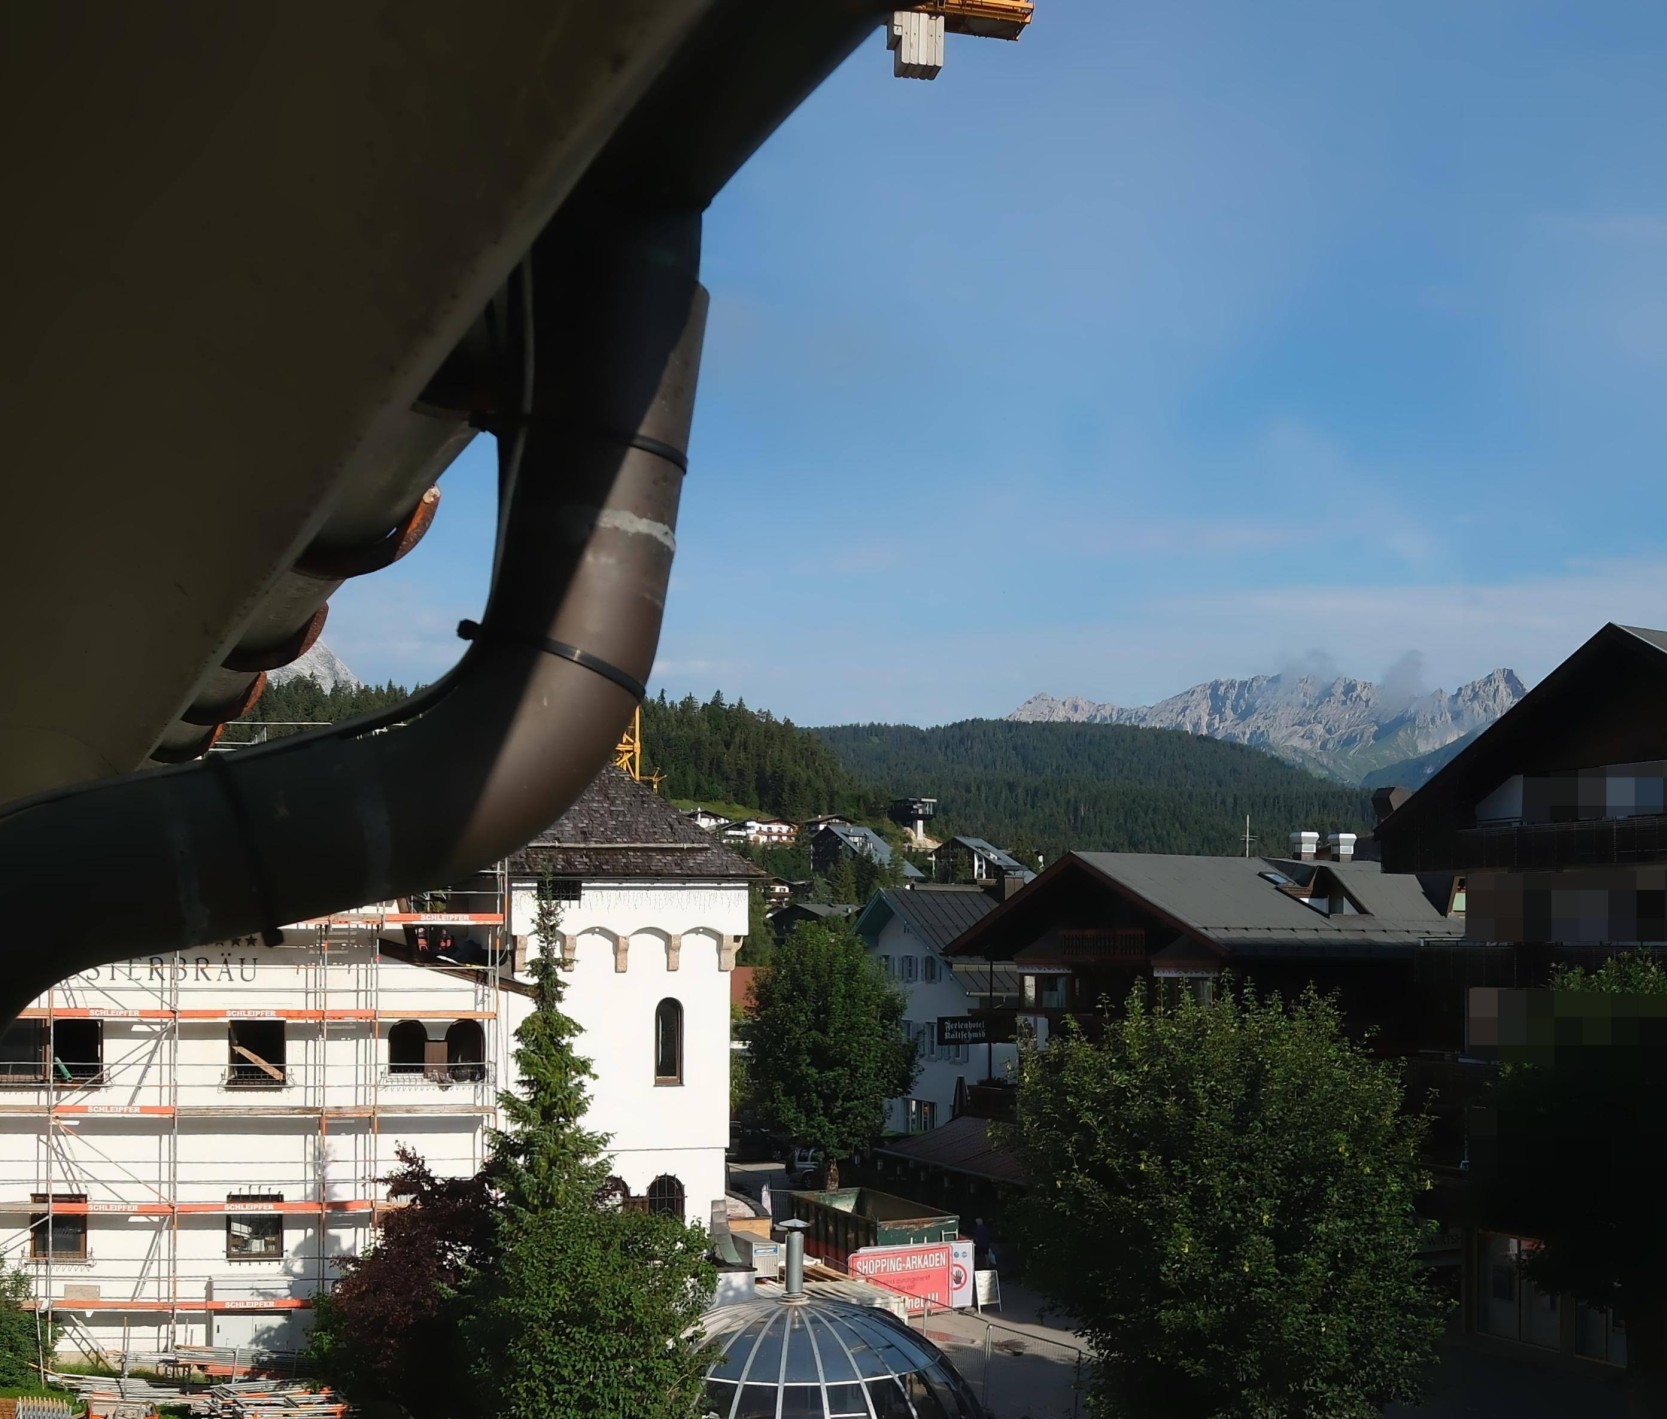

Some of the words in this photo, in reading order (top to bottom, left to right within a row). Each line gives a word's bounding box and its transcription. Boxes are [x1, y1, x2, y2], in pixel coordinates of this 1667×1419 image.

[420, 913, 470, 921] SCHLEIPFER
[89, 1009, 140, 1017] SCHLEIPFER
[226, 1009, 276, 1017] SCHLEIPFER
[857, 1252, 946, 1275] SHOPPING-ARKADEN
